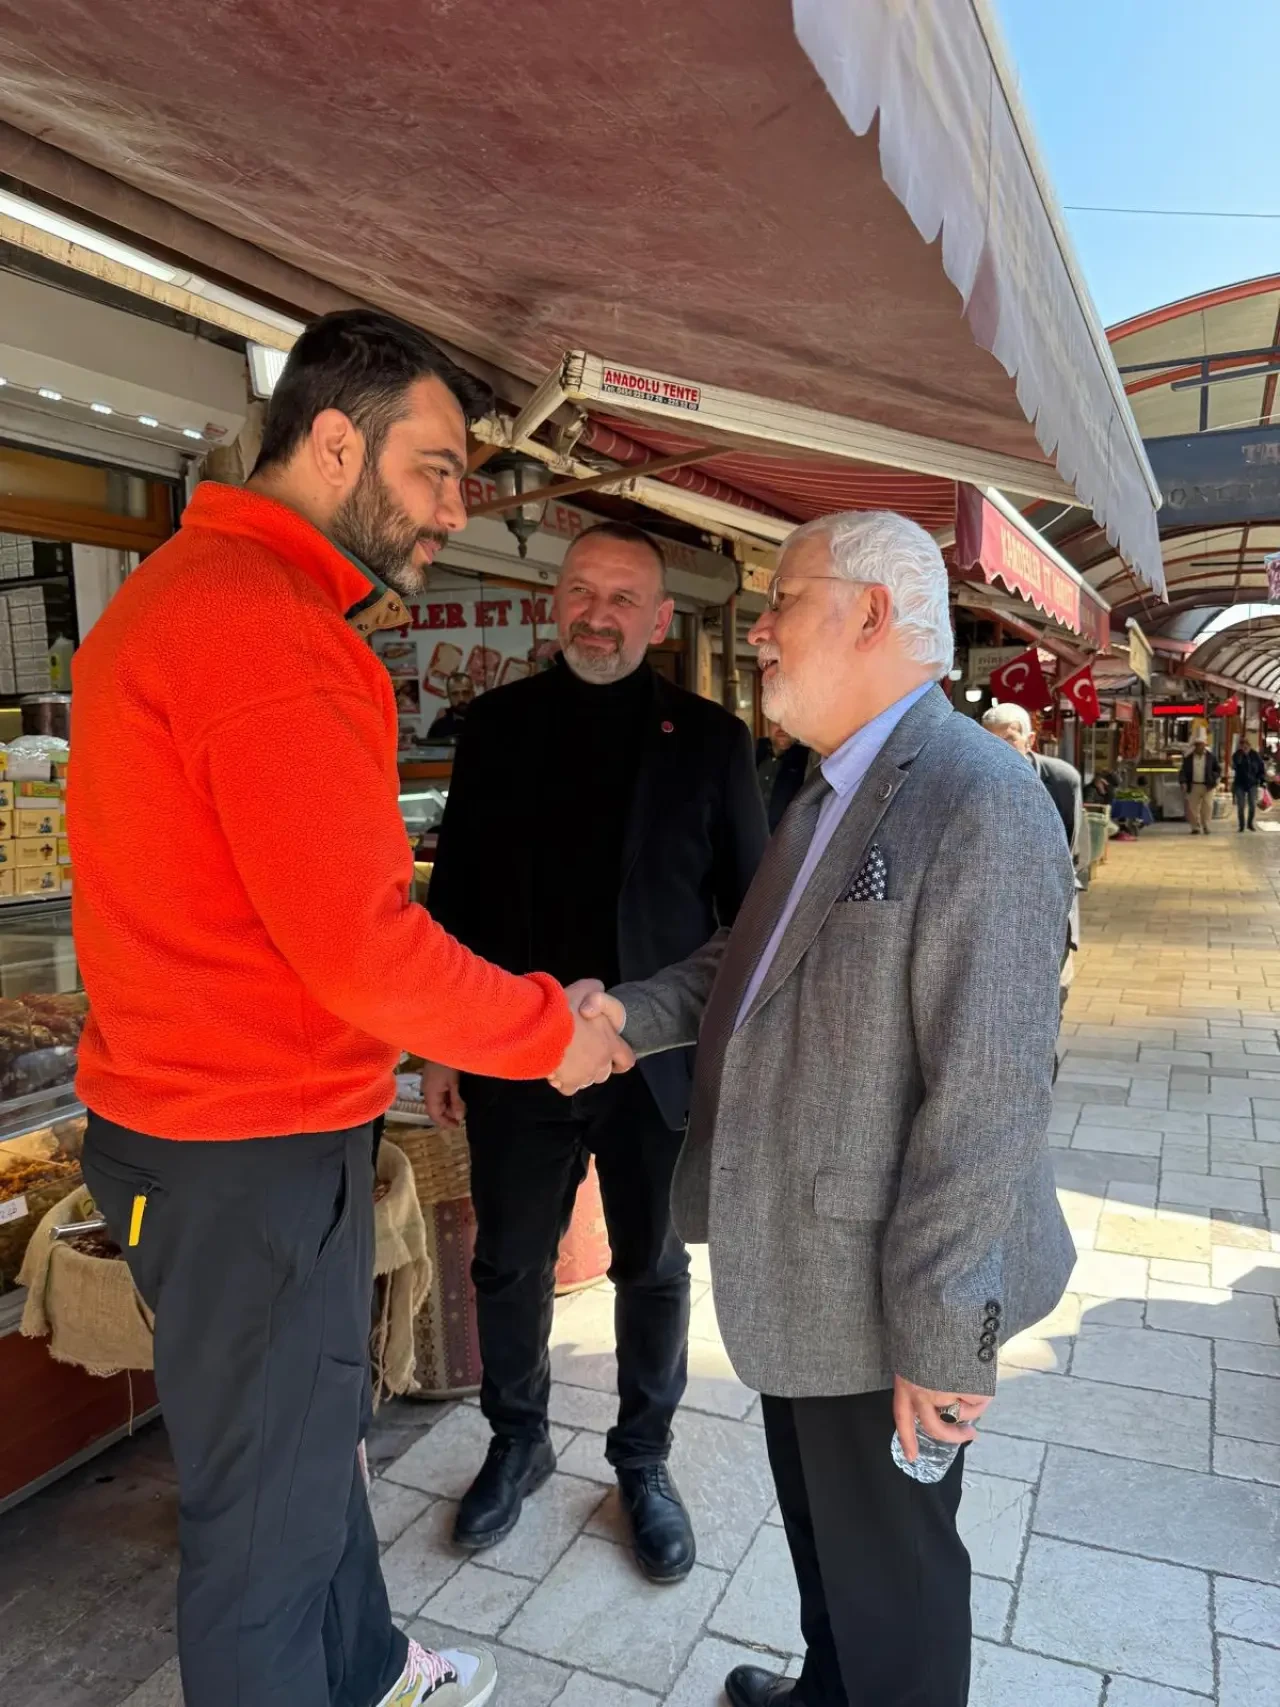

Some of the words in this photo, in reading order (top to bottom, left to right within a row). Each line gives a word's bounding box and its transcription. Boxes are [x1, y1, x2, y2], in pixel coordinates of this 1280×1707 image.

[605, 370, 659, 394] ANADOLU
[662, 383, 698, 402] TENTE
[400, 602, 468, 638] LER
[473, 599, 512, 628] ET
